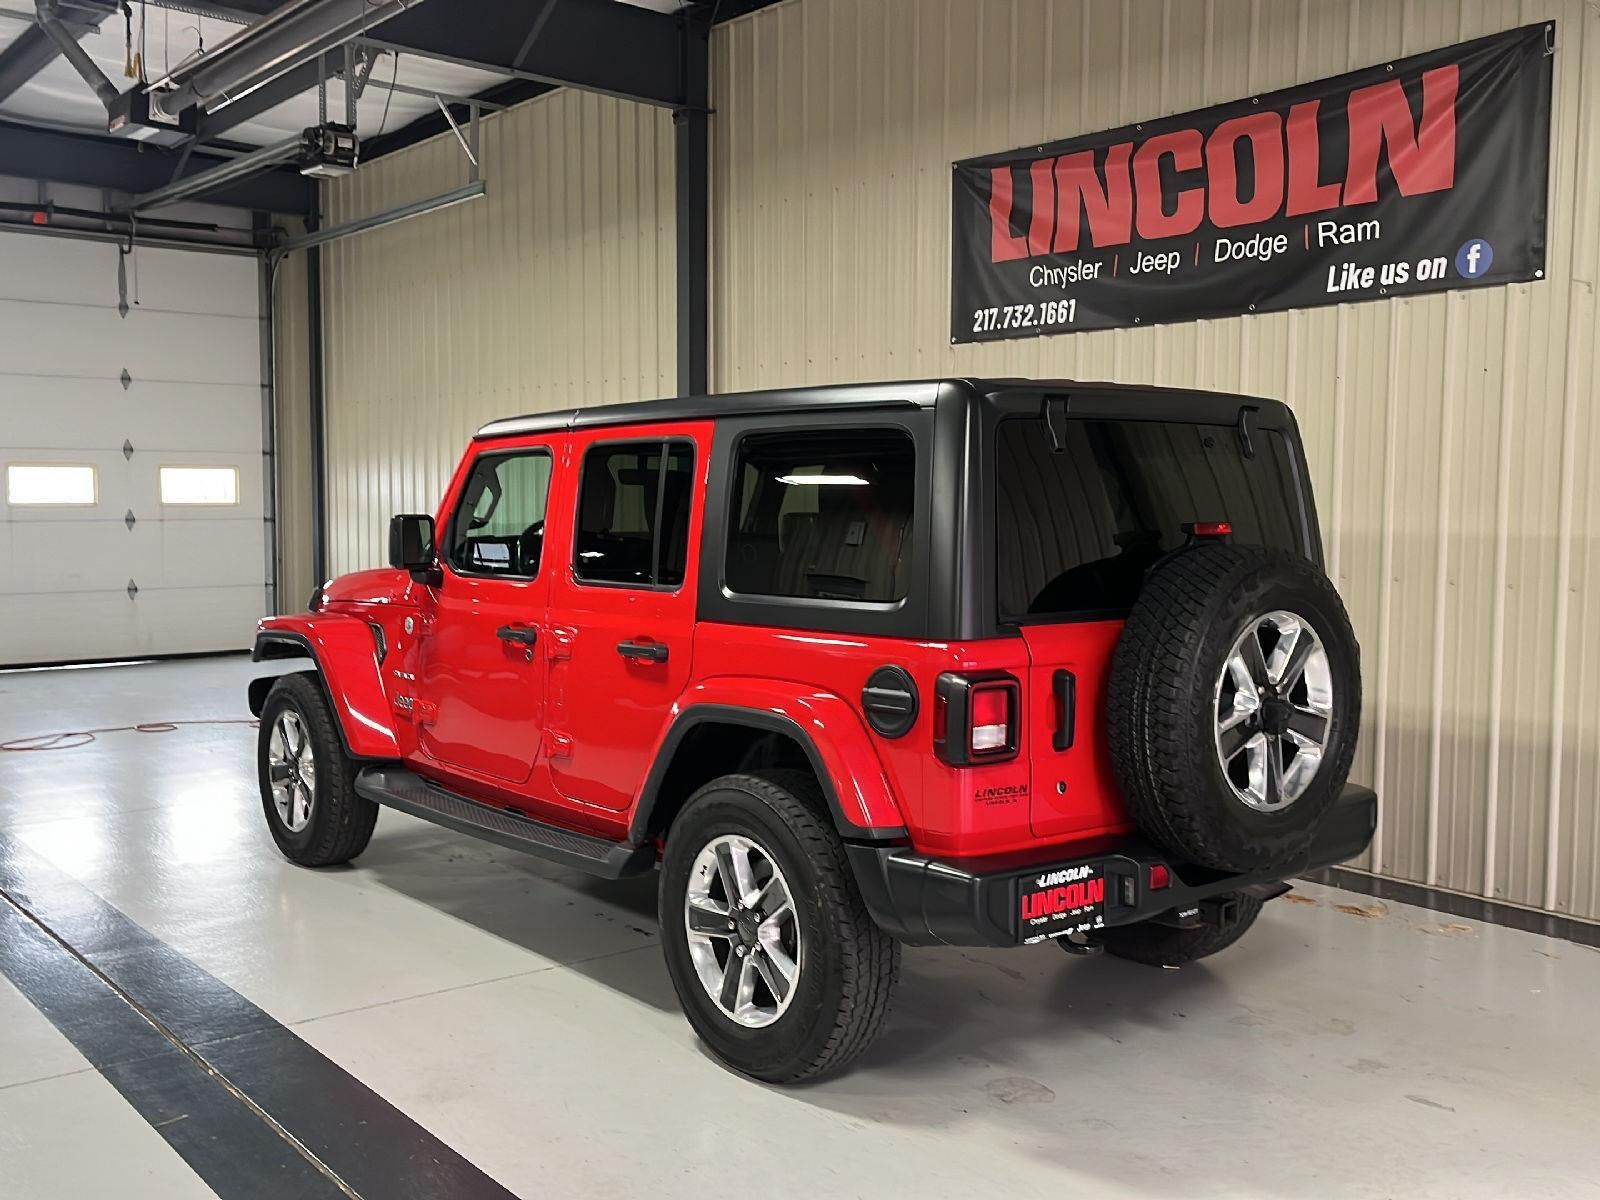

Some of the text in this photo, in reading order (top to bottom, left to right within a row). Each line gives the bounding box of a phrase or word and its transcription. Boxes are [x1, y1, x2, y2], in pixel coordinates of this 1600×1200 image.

[990, 64, 1459, 263] LINCOLN
[1029, 219, 1380, 288] Chrysler Jeep Dodge Ram
[1327, 264, 1374, 293] Like
[1380, 261, 1409, 285] us
[1416, 256, 1447, 282] on
[972, 298, 1076, 333] 217.732.1661
[975, 784, 1028, 798] LINCOLN
[1039, 865, 1090, 888] LINCOLN
[1022, 878, 1104, 920] LINCOLN
